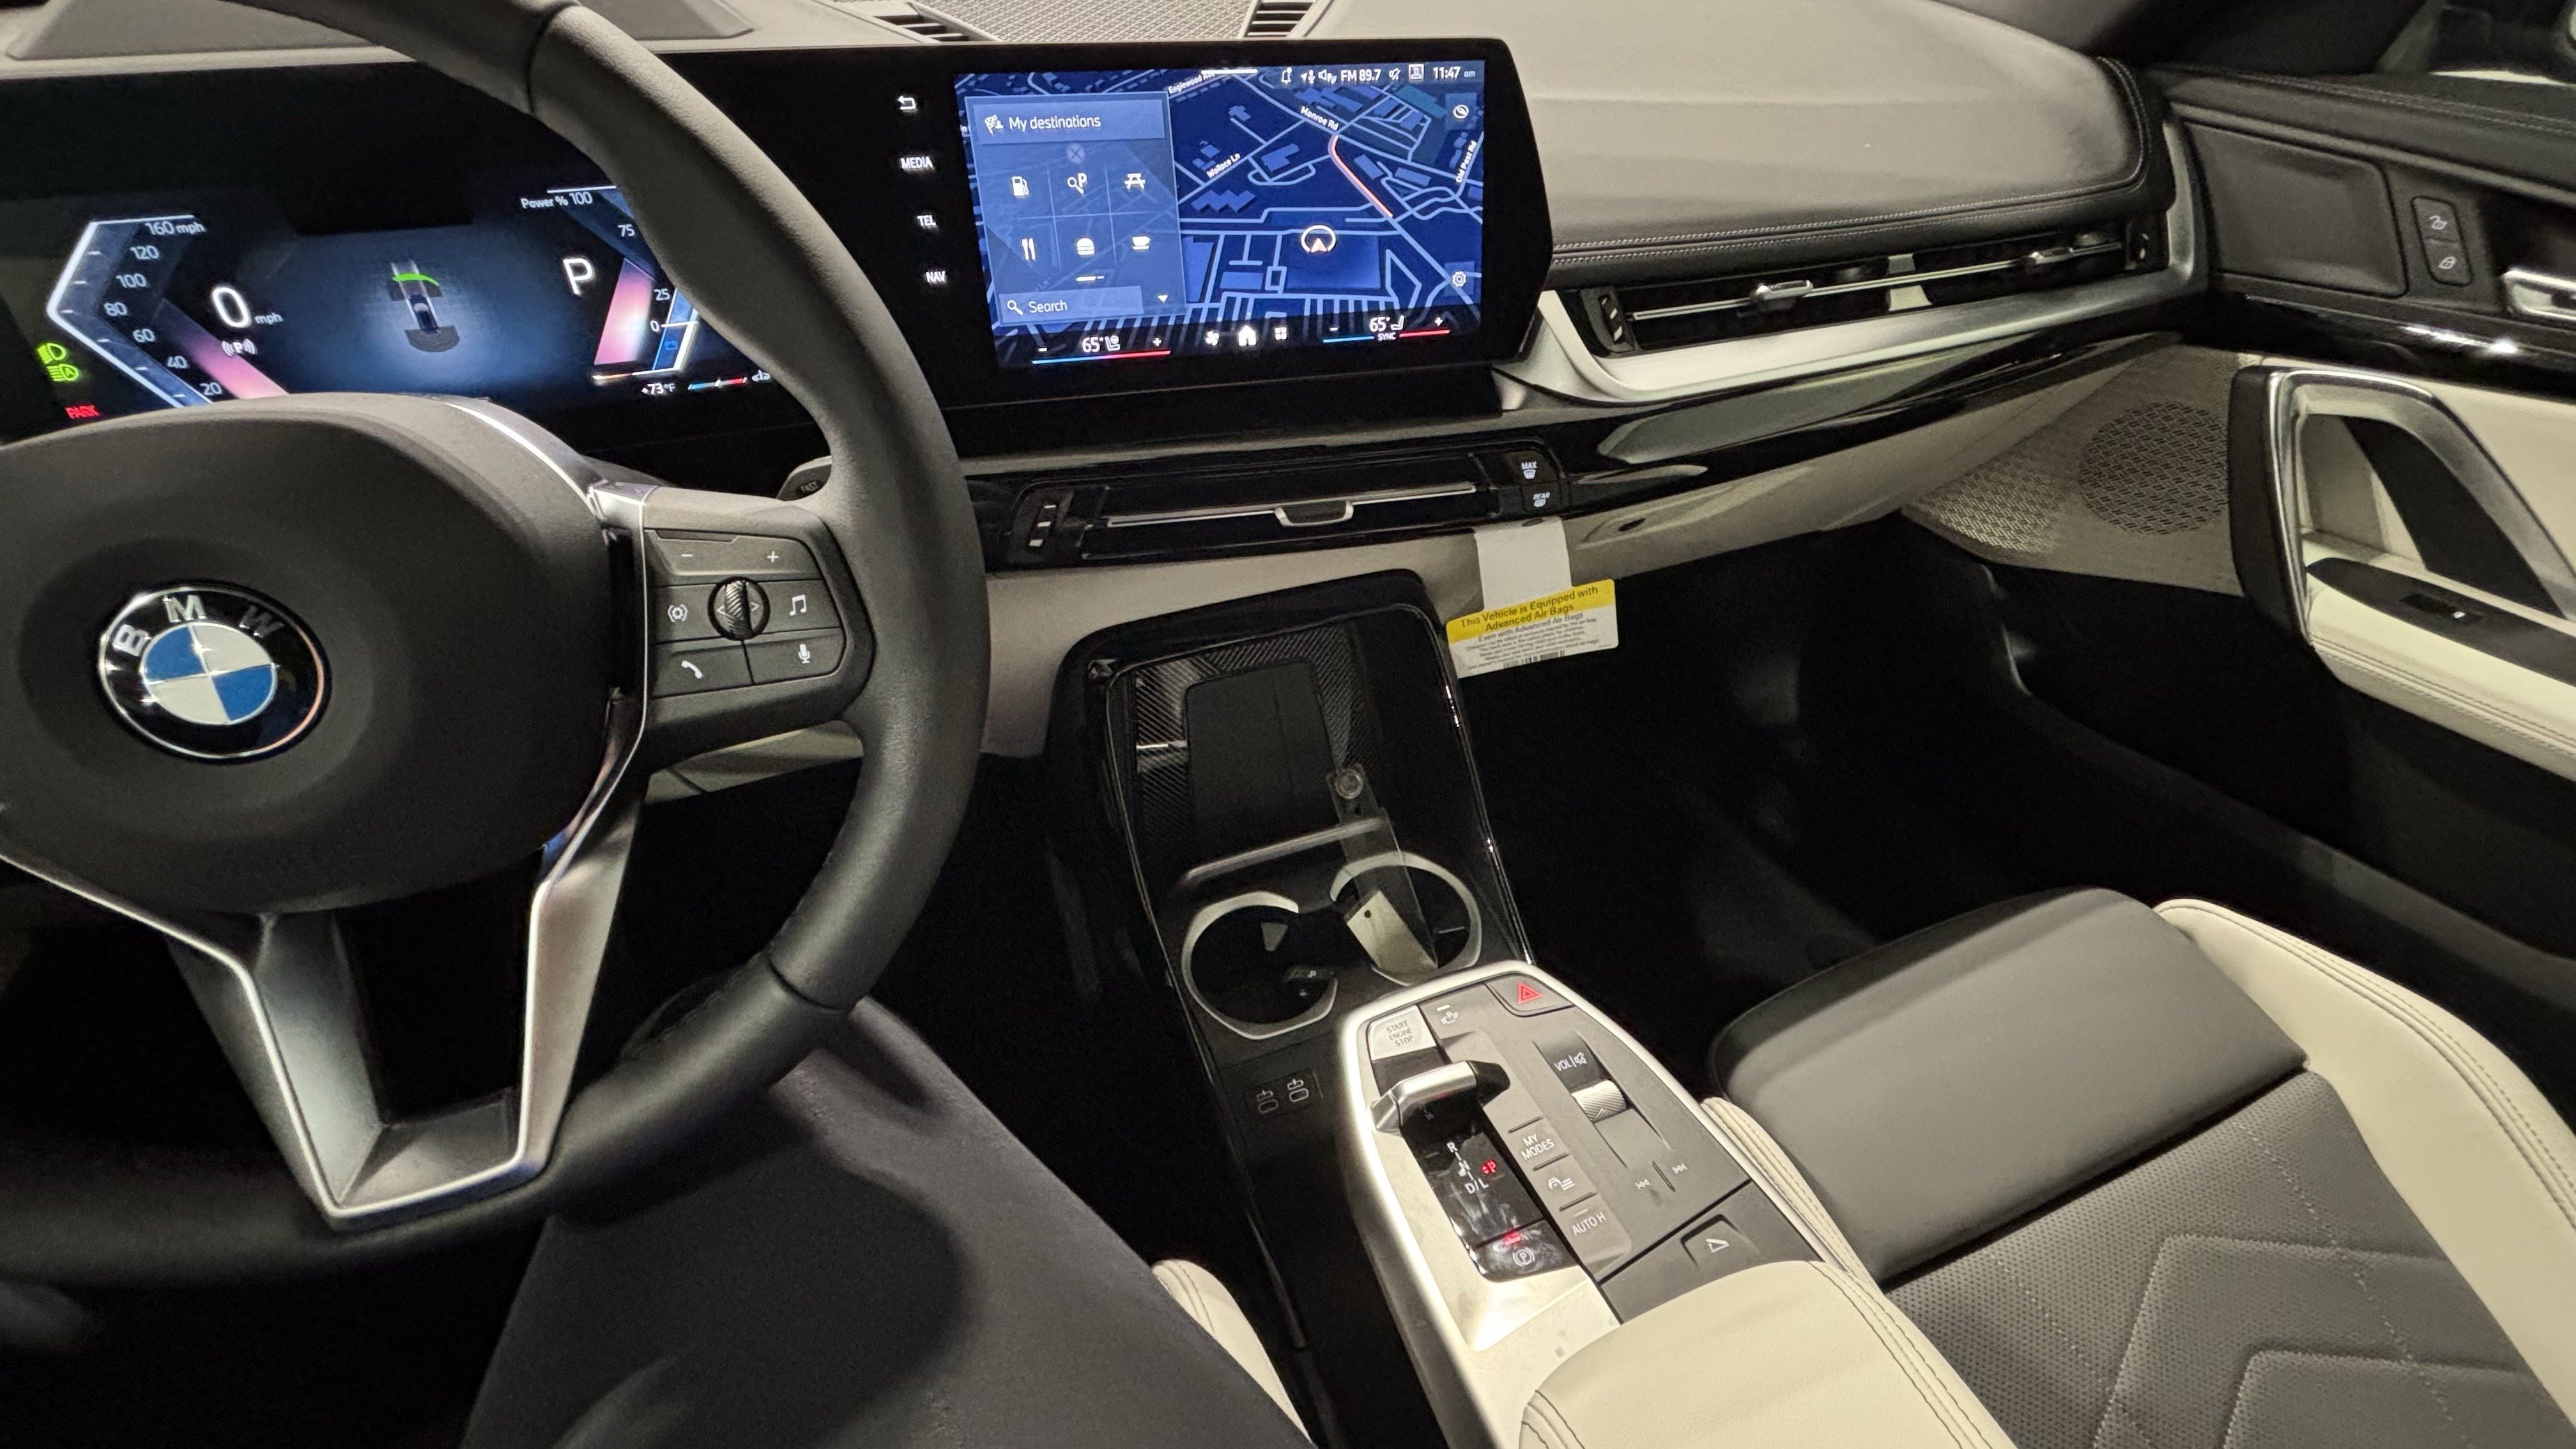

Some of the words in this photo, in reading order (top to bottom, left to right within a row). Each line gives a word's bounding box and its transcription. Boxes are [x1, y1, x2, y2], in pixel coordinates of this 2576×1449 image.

[1341, 70, 1357, 81] FM
[1359, 69, 1381, 81] 89.7
[1433, 66, 1460, 79] 11:47
[1009, 116, 1027, 132] My
[1030, 115, 1101, 130] destinations
[1301, 105, 1328, 126] Monroe
[1328, 119, 1339, 131] Rd
[1468, 140, 1477, 152] Rd
[900, 157, 933, 169] MEDIA
[1206, 158, 1232, 178] Wallace
[1230, 153, 1241, 162] Ln
[1460, 151, 1473, 170] Post
[1456, 169, 1466, 183] Old
[521, 195, 554, 209] Power
[555, 195, 569, 207] %
[569, 192, 593, 206] 100
[145, 220, 175, 236] 160
[176, 222, 206, 234] mph
[917, 215, 937, 227] TEL
[618, 224, 635, 238] 75
[130, 245, 160, 260] 120
[116, 273, 148, 288] 100
[562, 257, 594, 296] P
[926, 271, 946, 283] NAV
[654, 288, 671, 301] 25
[104, 302, 127, 317] 80
[211, 286, 251, 329] 0
[255, 312, 283, 325] mph
[1029, 300, 1068, 314] Search
[650, 321, 660, 333] 0
[133, 328, 155, 344] 60
[1378, 332, 1397, 341] SYNC
[166, 355, 188, 371] 40
[200, 382, 222, 396] 20
[1521, 461, 1538, 470] MAX
[1533, 491, 1551, 501] REAR
[1461, 617, 1480, 628] This
[1482, 609, 1517, 622] Vehicle
[1520, 604, 1528, 613] is
[1530, 590, 1575, 610] Equipped
[1577, 586, 1598, 597] with
[1485, 614, 1532, 632] Advanced
[1535, 610, 1548, 621] Air
[1550, 603, 1574, 615] Bags
[112, 594, 284, 657] BMW
[1515, 618, 1551, 633] Advanced
[1386, 1020, 1408, 1034] START
[1388, 1027, 1414, 1041] ENGINE
[1395, 1035, 1413, 1047] STOP
[1554, 1059, 1572, 1073] VOL
[1522, 1133, 1539, 1147] MY
[1446, 1142, 1458, 1153] R
[1521, 1138, 1555, 1160] MODES
[1572, 1215, 1597, 1236] AUTO
[1596, 1211, 1607, 1223] H
